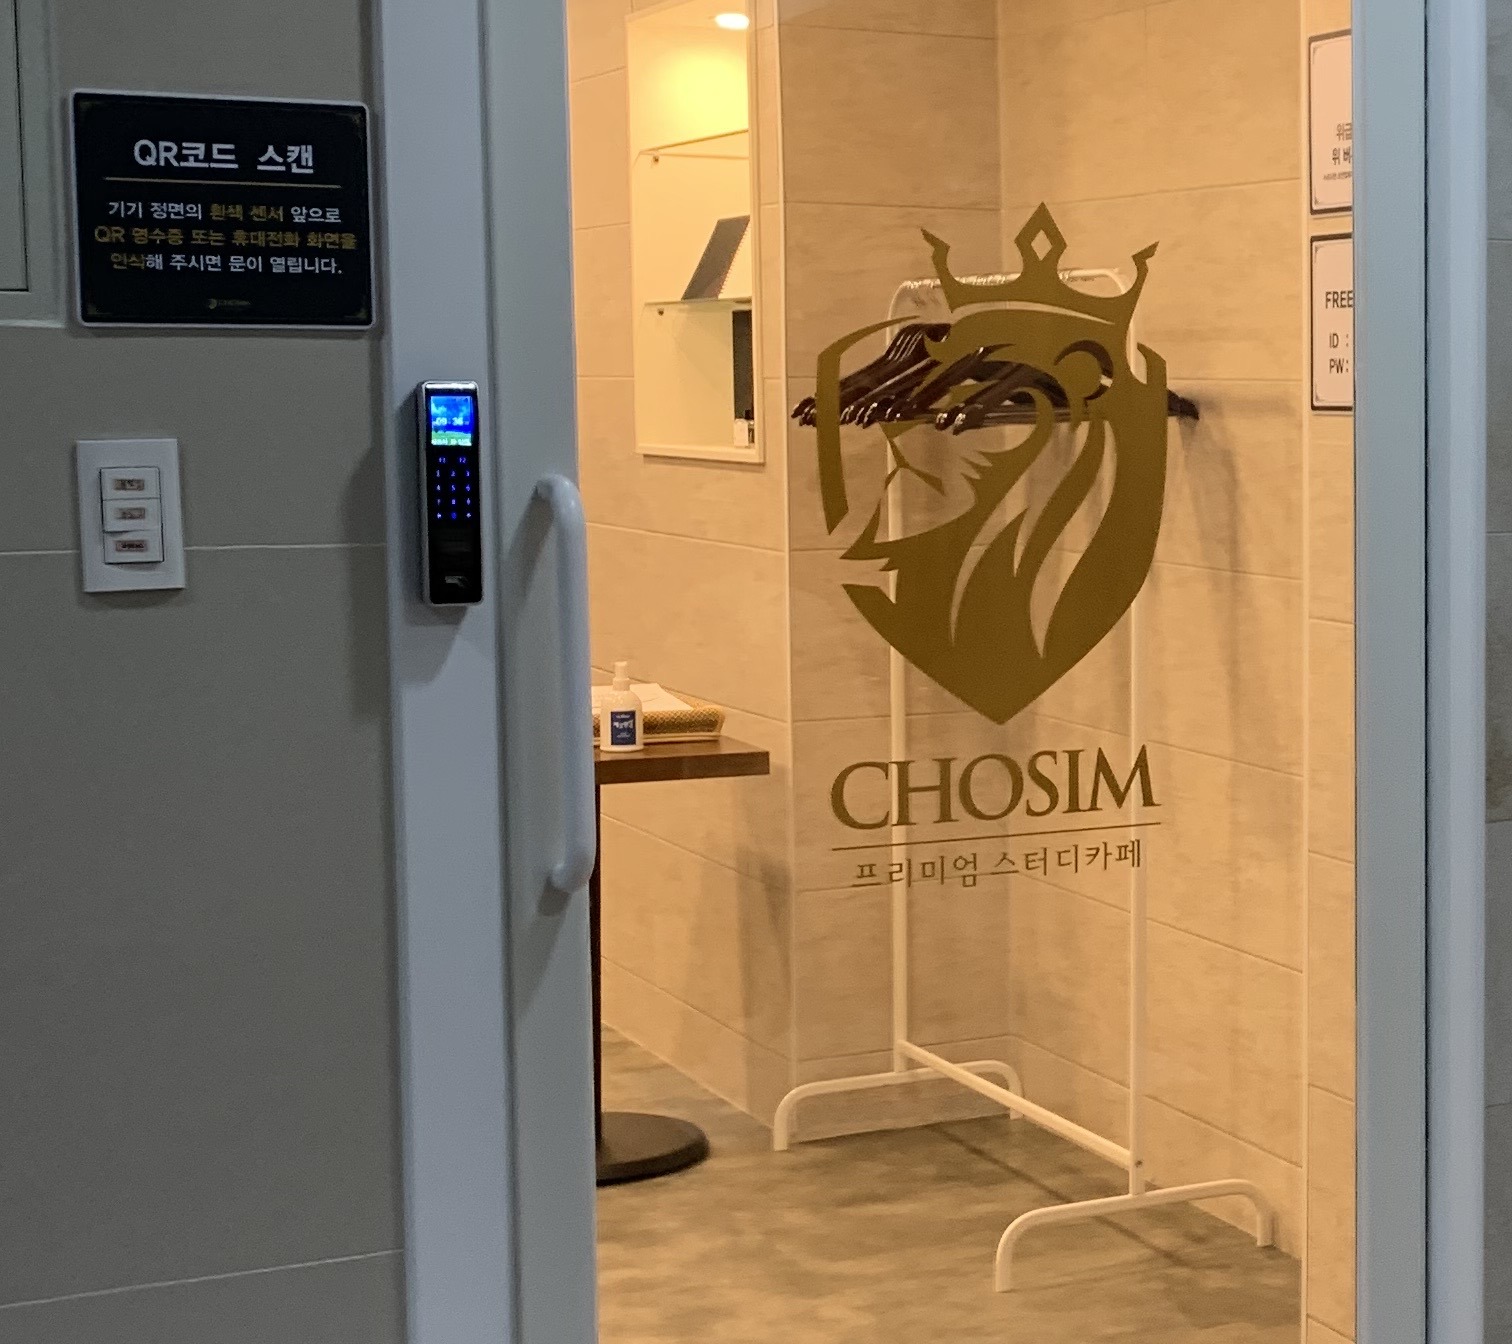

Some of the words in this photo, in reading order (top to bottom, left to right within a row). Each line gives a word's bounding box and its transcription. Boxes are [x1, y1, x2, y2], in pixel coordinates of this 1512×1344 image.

[134, 139, 239, 169] QR코드
[257, 144, 314, 174] 스캔
[108, 201, 143, 219] 기기
[150, 203, 202, 220] 정면의
[250, 206, 284, 222] 센서
[290, 206, 341, 223] 앞으로
[94, 226, 125, 244] QR
[131, 227, 185, 246] 영수증
[191, 229, 226, 246] 또는
[232, 230, 300, 248] 휴대전화
[306, 231, 357, 250] 화면을
[111, 253, 163, 270] 인식해
[169, 254, 222, 271] 주시면
[228, 255, 262, 272] 문이
[270, 256, 343, 274] 열립니다.
[1325, 290, 1353, 309] FREE
[830, 744, 1162, 830] CHOSIM
[851, 852, 978, 888] 프리미엄
[989, 839, 1141, 877] 스터디카페
